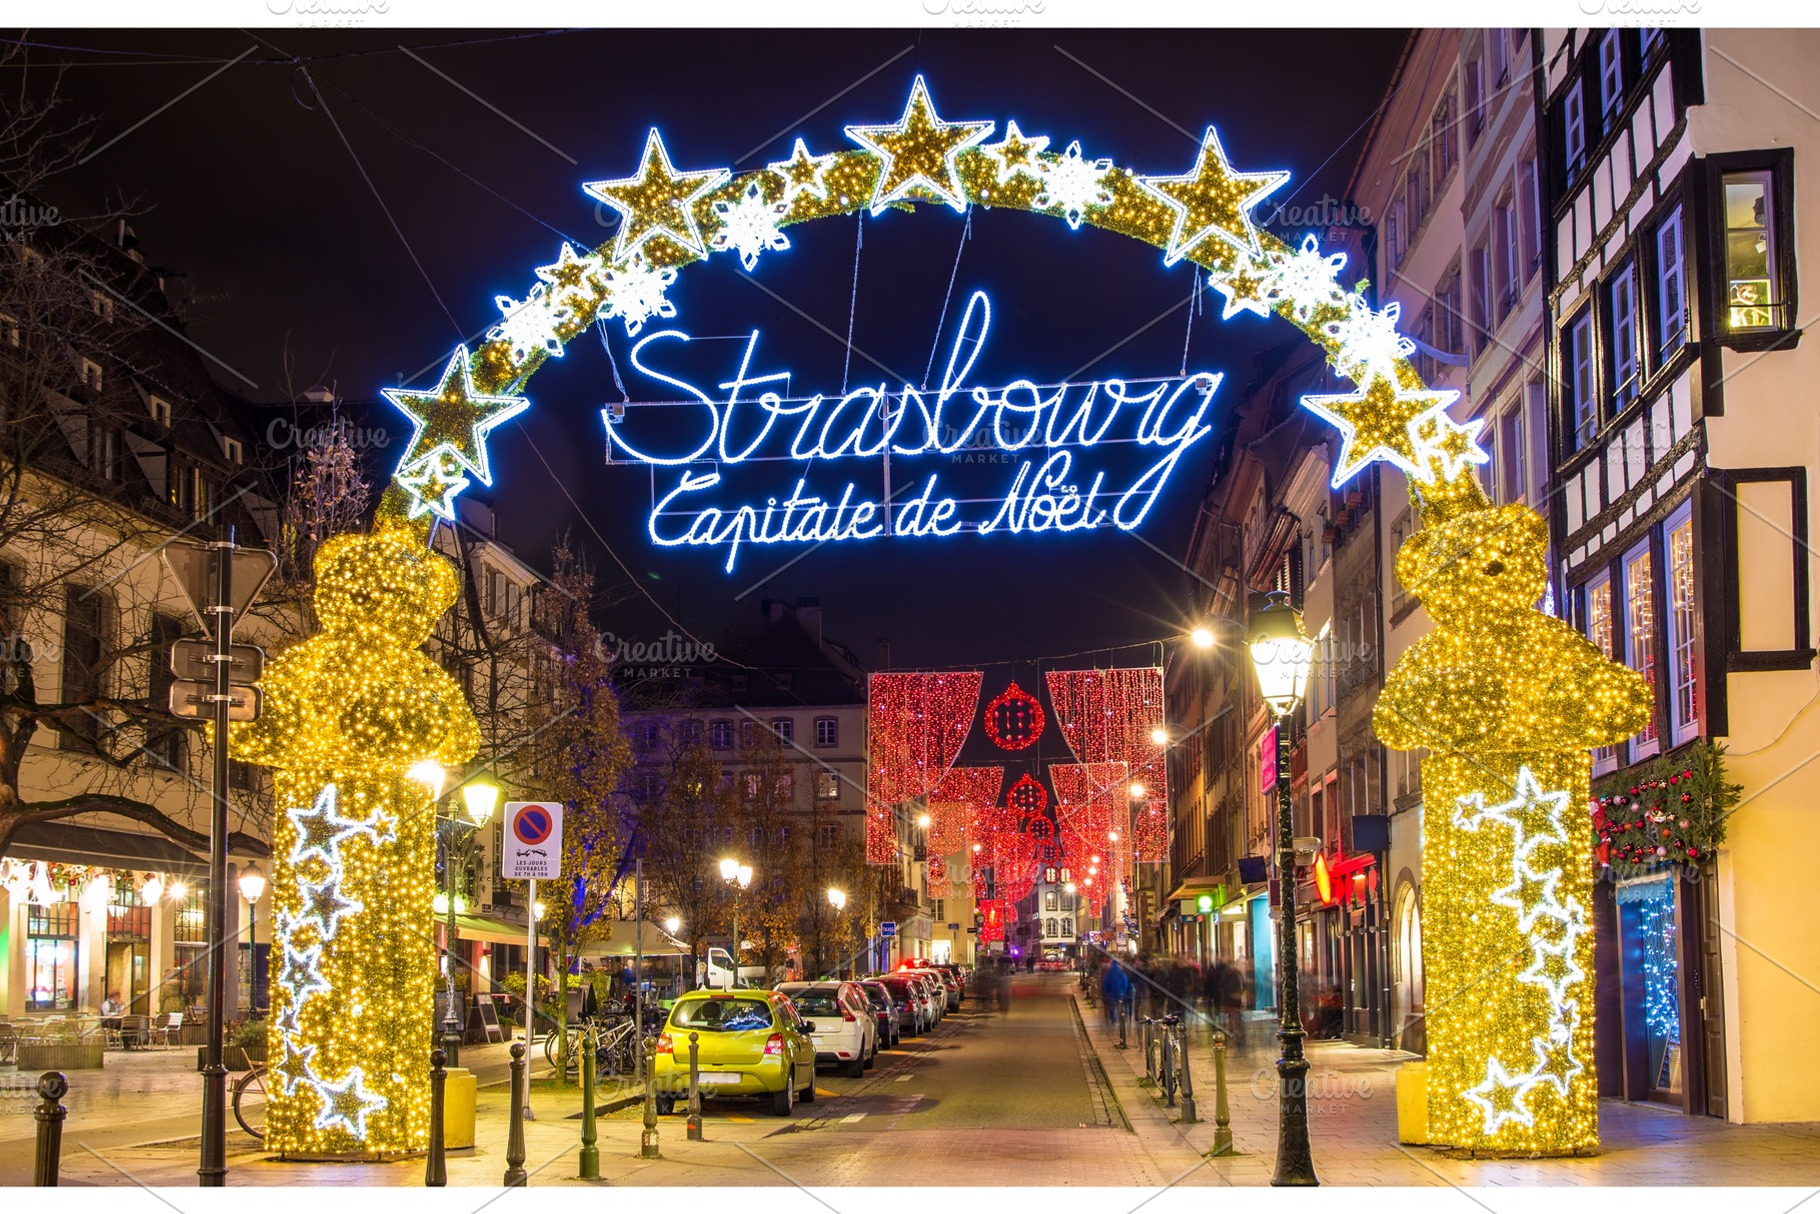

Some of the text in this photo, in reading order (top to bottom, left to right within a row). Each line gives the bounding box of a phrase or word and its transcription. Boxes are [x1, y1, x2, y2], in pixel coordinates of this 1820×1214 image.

[602, 291, 1224, 530] Strasbourg
[648, 450, 1107, 573] Capitale de Noël
